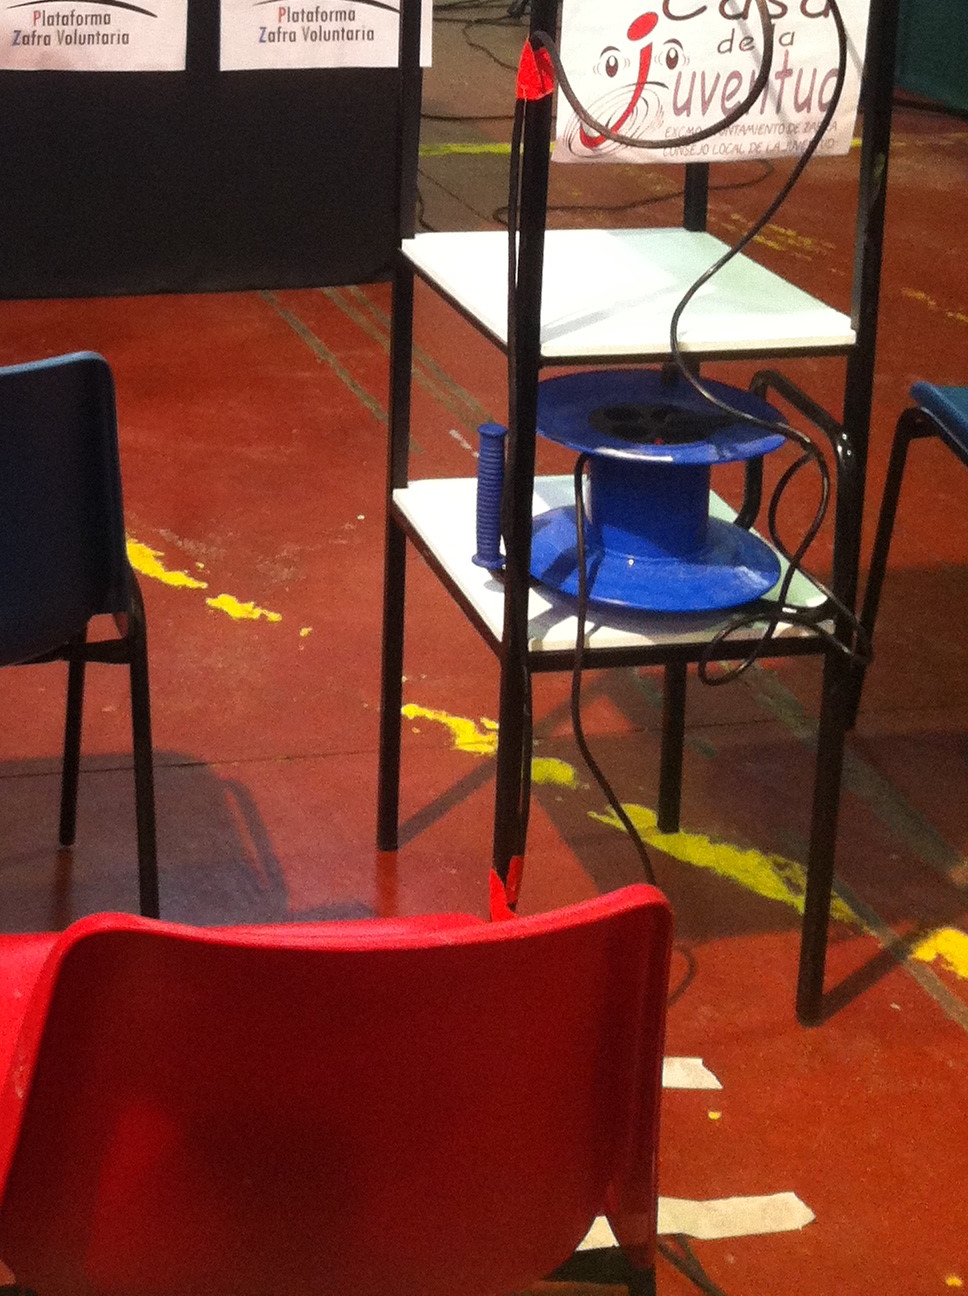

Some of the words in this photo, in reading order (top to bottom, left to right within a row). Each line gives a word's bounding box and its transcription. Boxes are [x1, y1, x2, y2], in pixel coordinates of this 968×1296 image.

[33, 9, 111, 27] Plataforma
[278, 5, 356, 23] Plataforma
[11, 29, 52, 47] Zafra
[57, 27, 130, 46] Voluntaria
[258, 26, 297, 44] Zafra
[302, 24, 375, 42] Voluntaria
[717, 28, 756, 55] de
[712, 142, 745, 156] LOCAL
[748, 141, 762, 154] DE
